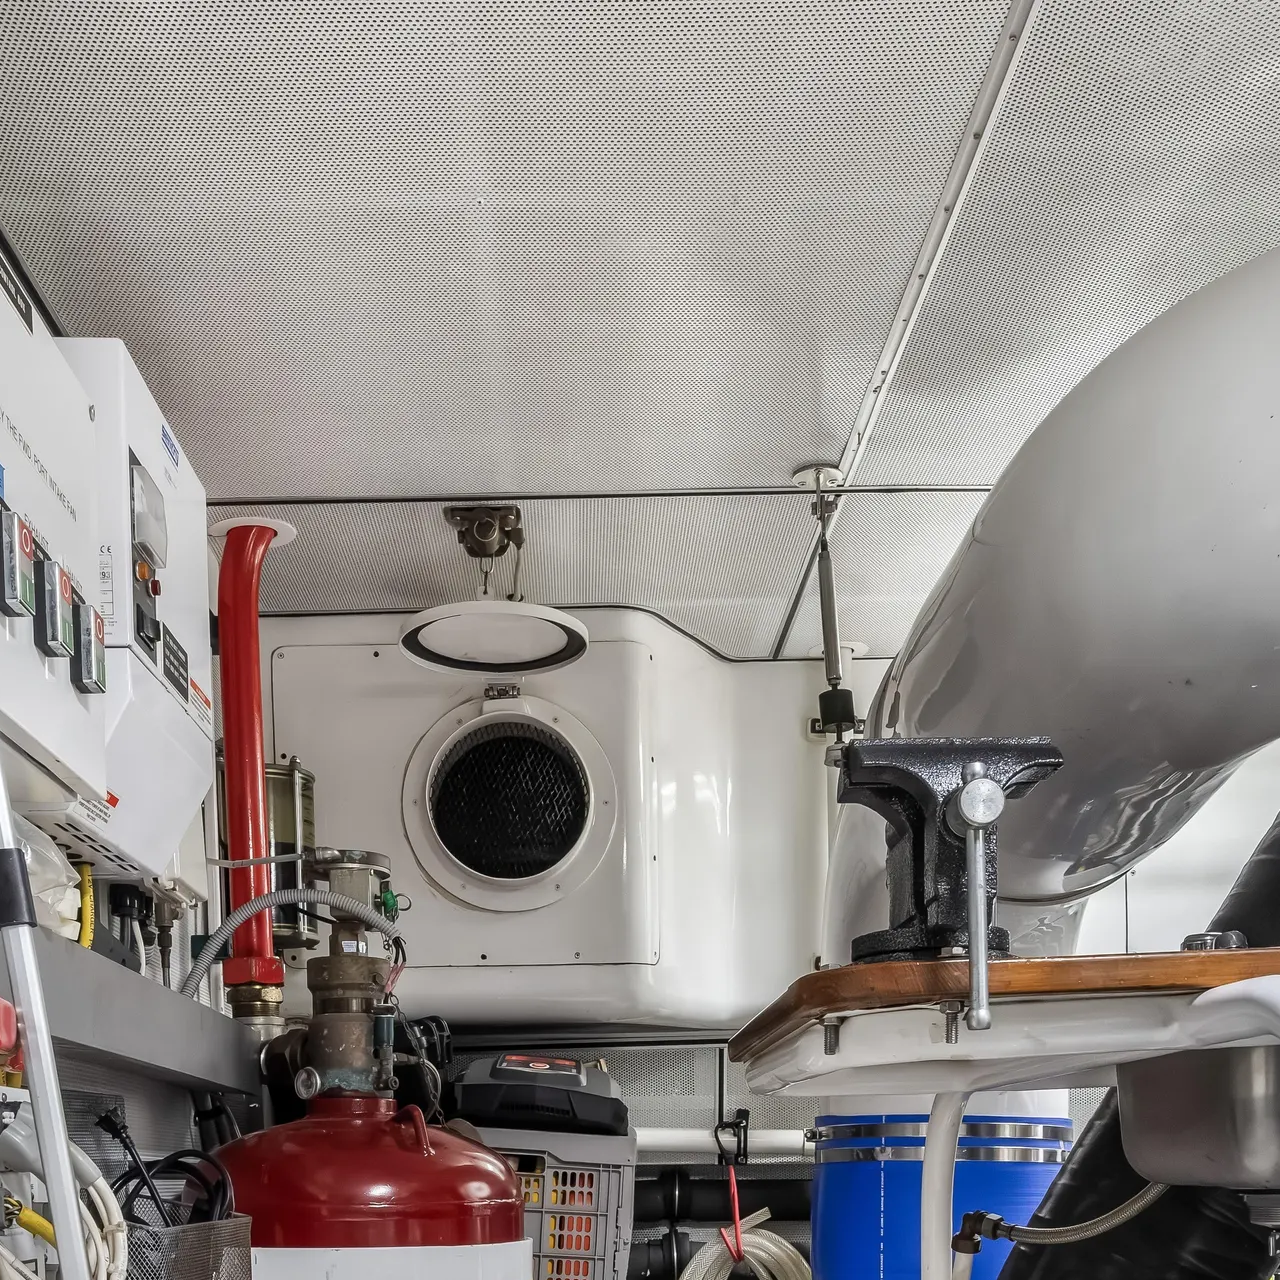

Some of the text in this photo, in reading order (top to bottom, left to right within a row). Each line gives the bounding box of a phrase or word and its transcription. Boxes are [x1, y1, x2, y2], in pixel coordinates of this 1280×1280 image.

[4, 414, 19, 445] THE
[33, 454, 49, 483] PORT
[48, 473, 67, 511] INTAKE
[66, 500, 78, 523] FAN
